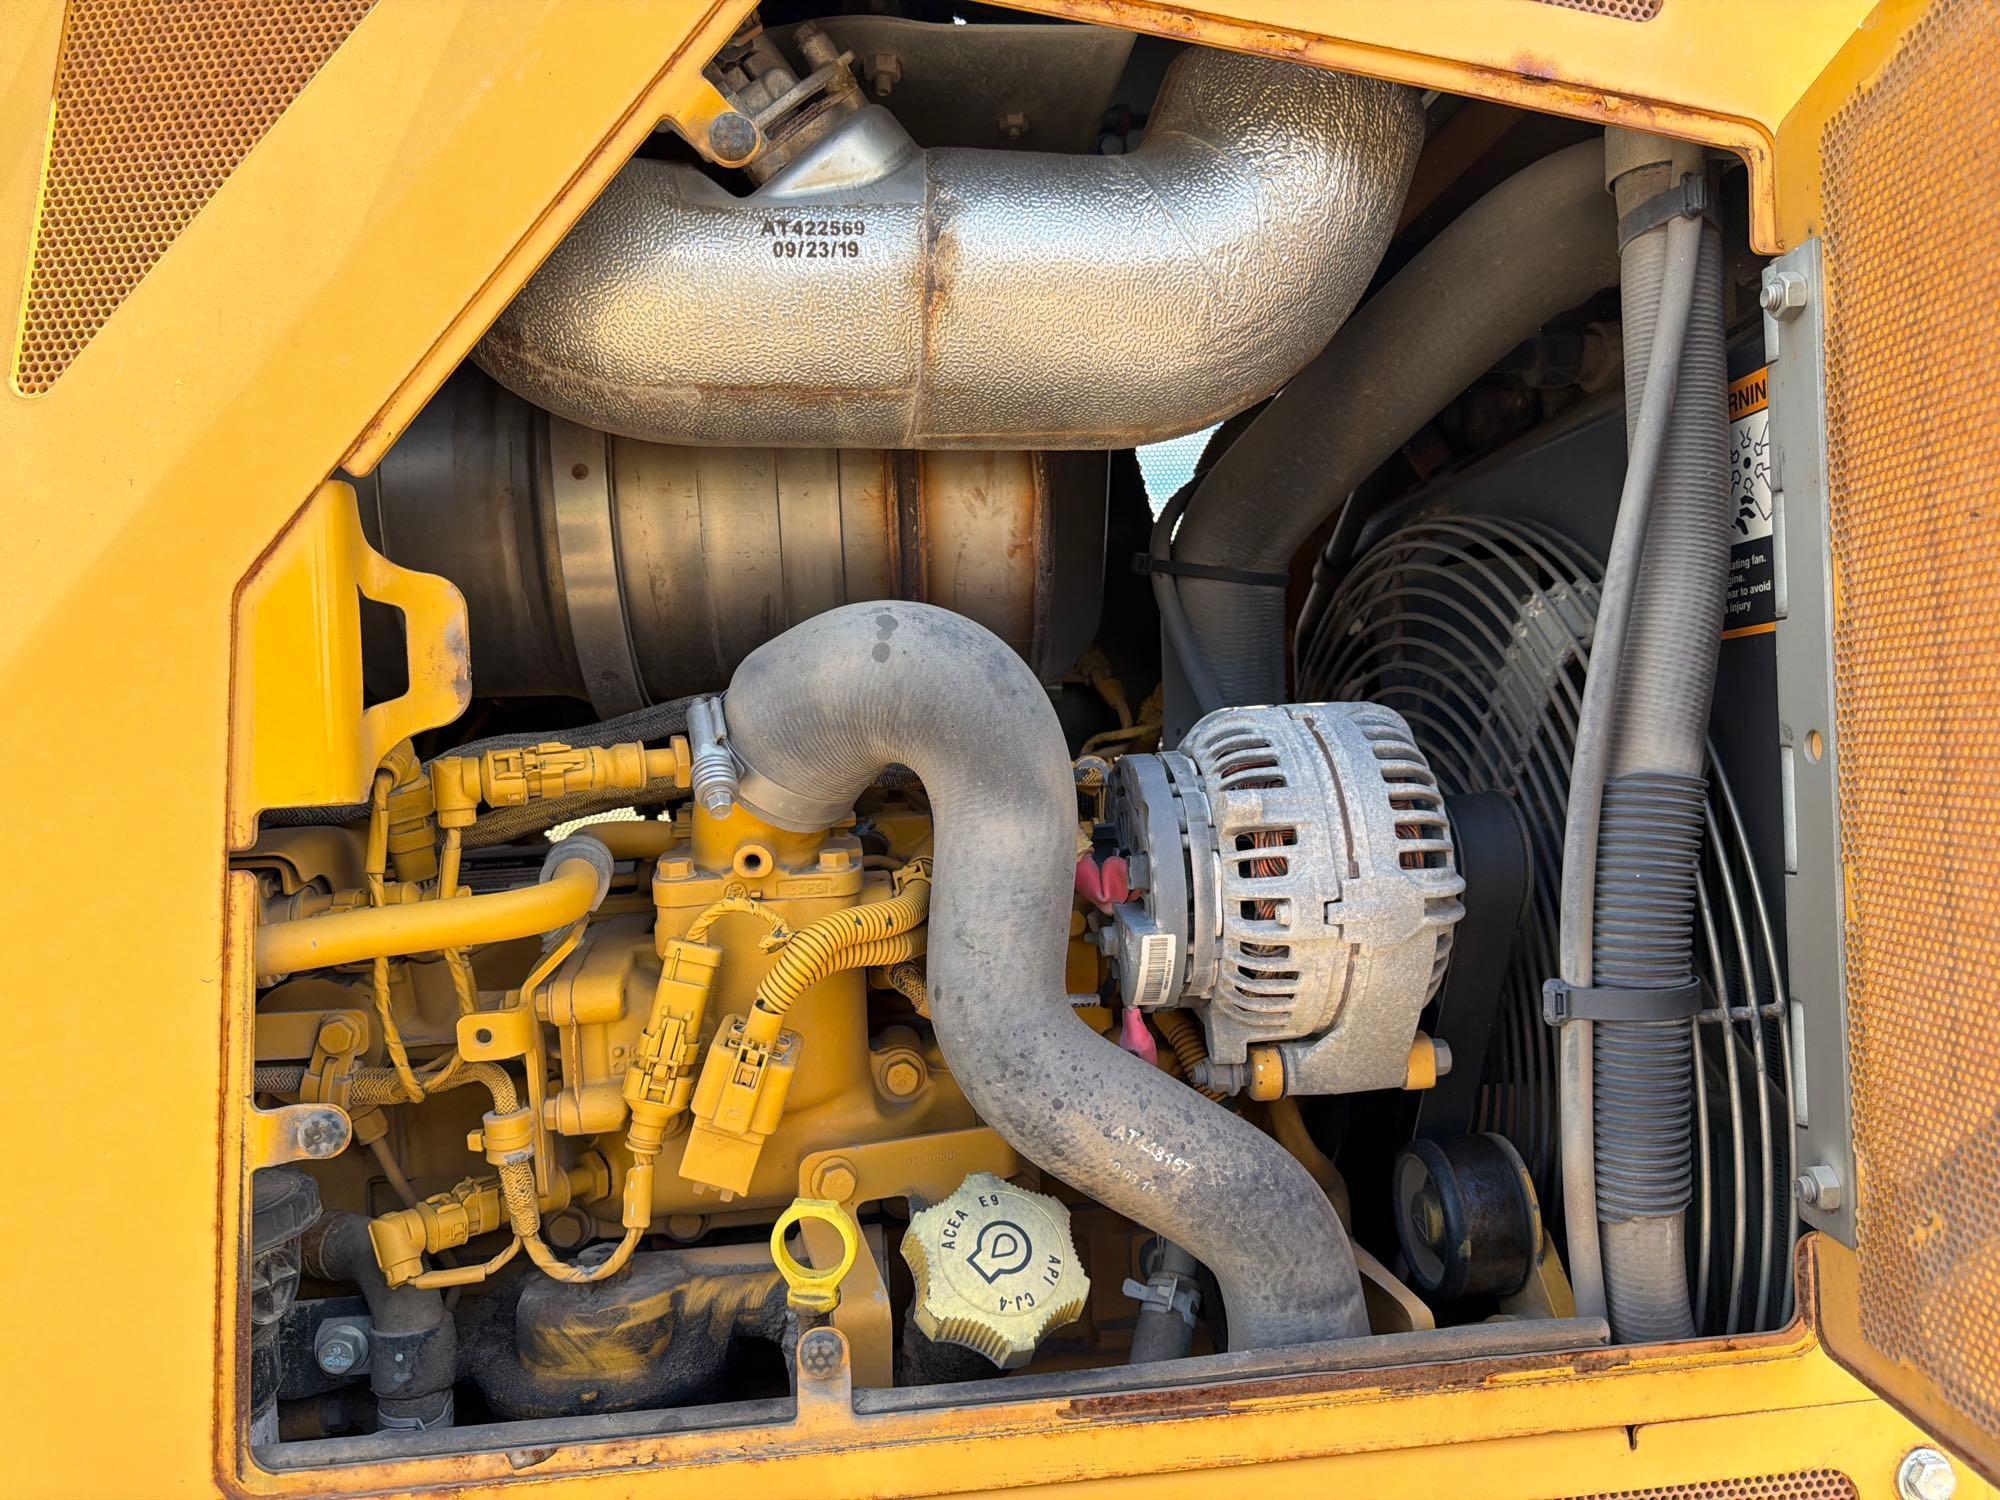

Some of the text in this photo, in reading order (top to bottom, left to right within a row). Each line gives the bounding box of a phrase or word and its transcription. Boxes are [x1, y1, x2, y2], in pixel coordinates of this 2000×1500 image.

[760, 221, 865, 236] AT422569
[773, 241, 859, 258] 09/23/19
[1728, 378, 1767, 414] RNIN
[1730, 554, 1767, 569] ating fan.
[1728, 574, 1745, 587] gine.
[1740, 587, 1748, 596] to
[1749, 580, 1771, 594] avoid
[1730, 601, 1751, 615] injury
[941, 1194, 999, 1250] ACEA E9
[999, 1254, 1062, 1312] API CJ-4
